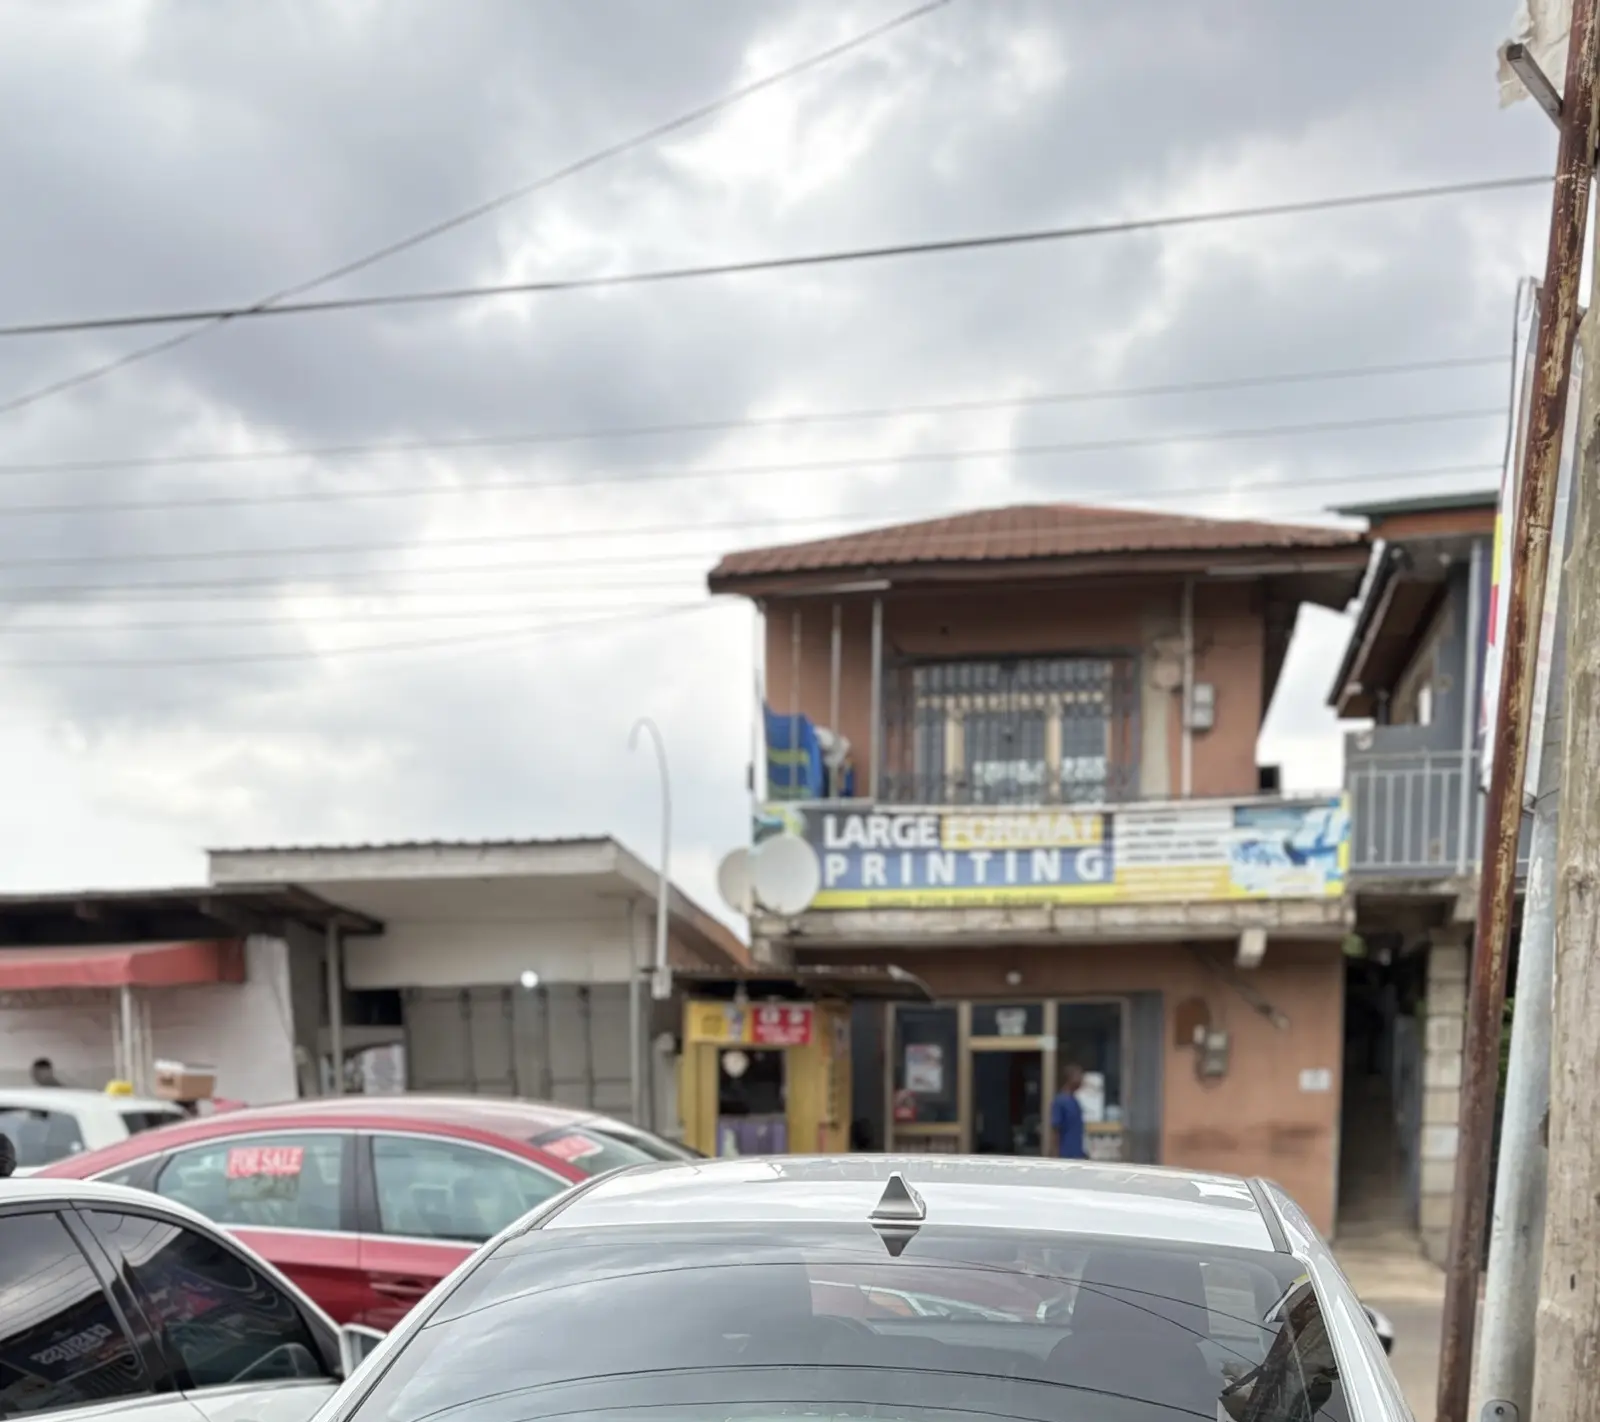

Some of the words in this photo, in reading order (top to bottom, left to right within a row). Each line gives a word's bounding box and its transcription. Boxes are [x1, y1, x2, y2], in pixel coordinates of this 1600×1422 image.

[823, 814, 941, 849] LARGE
[946, 813, 1099, 846] FORMAT
[824, 848, 1103, 888] PRINTING
[231, 1147, 258, 1175] FOR
[261, 1146, 303, 1172] SALE
